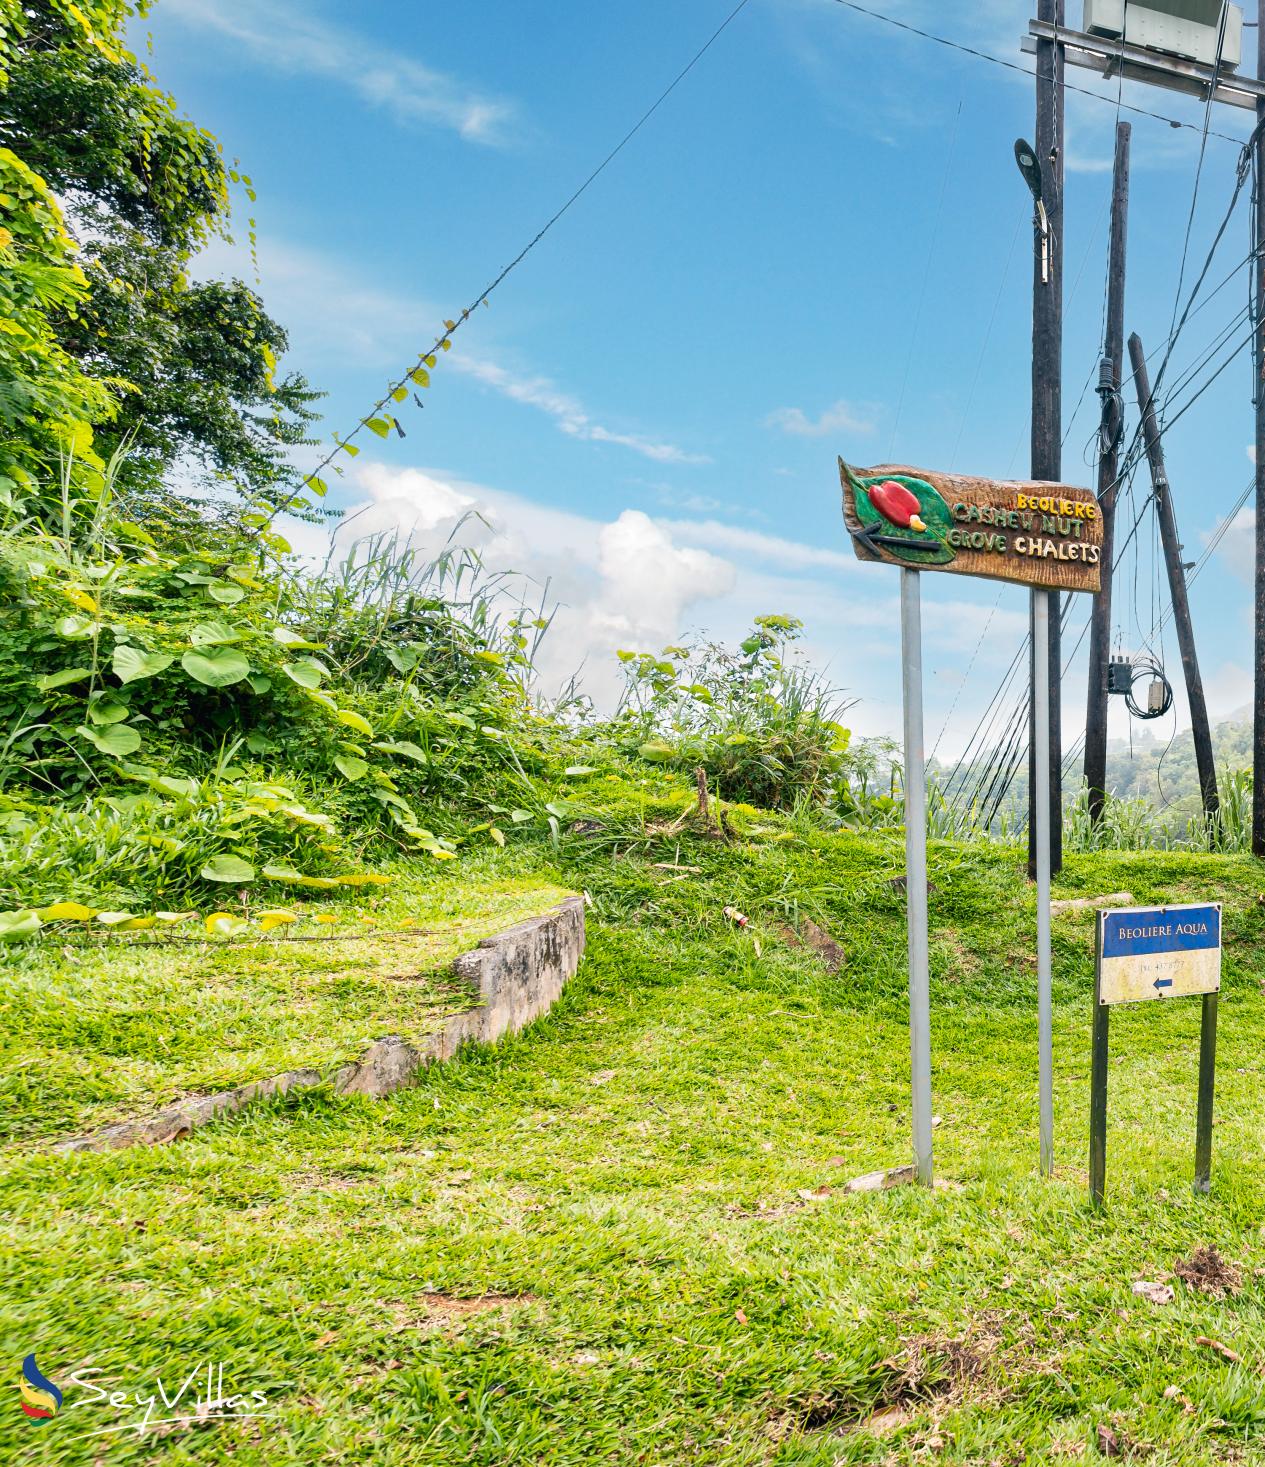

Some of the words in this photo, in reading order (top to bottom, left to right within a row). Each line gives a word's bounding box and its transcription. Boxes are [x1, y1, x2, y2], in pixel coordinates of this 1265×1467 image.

[953, 503, 1032, 531] CASHEW
[1042, 514, 1084, 538] NUT
[1017, 493, 1096, 519] BEOLIERE
[949, 529, 1007, 552] GROVE
[1015, 536, 1101, 564] CHALETS
[1119, 925, 1172, 940] BEOLIERE
[1175, 923, 1208, 936] AQUA
